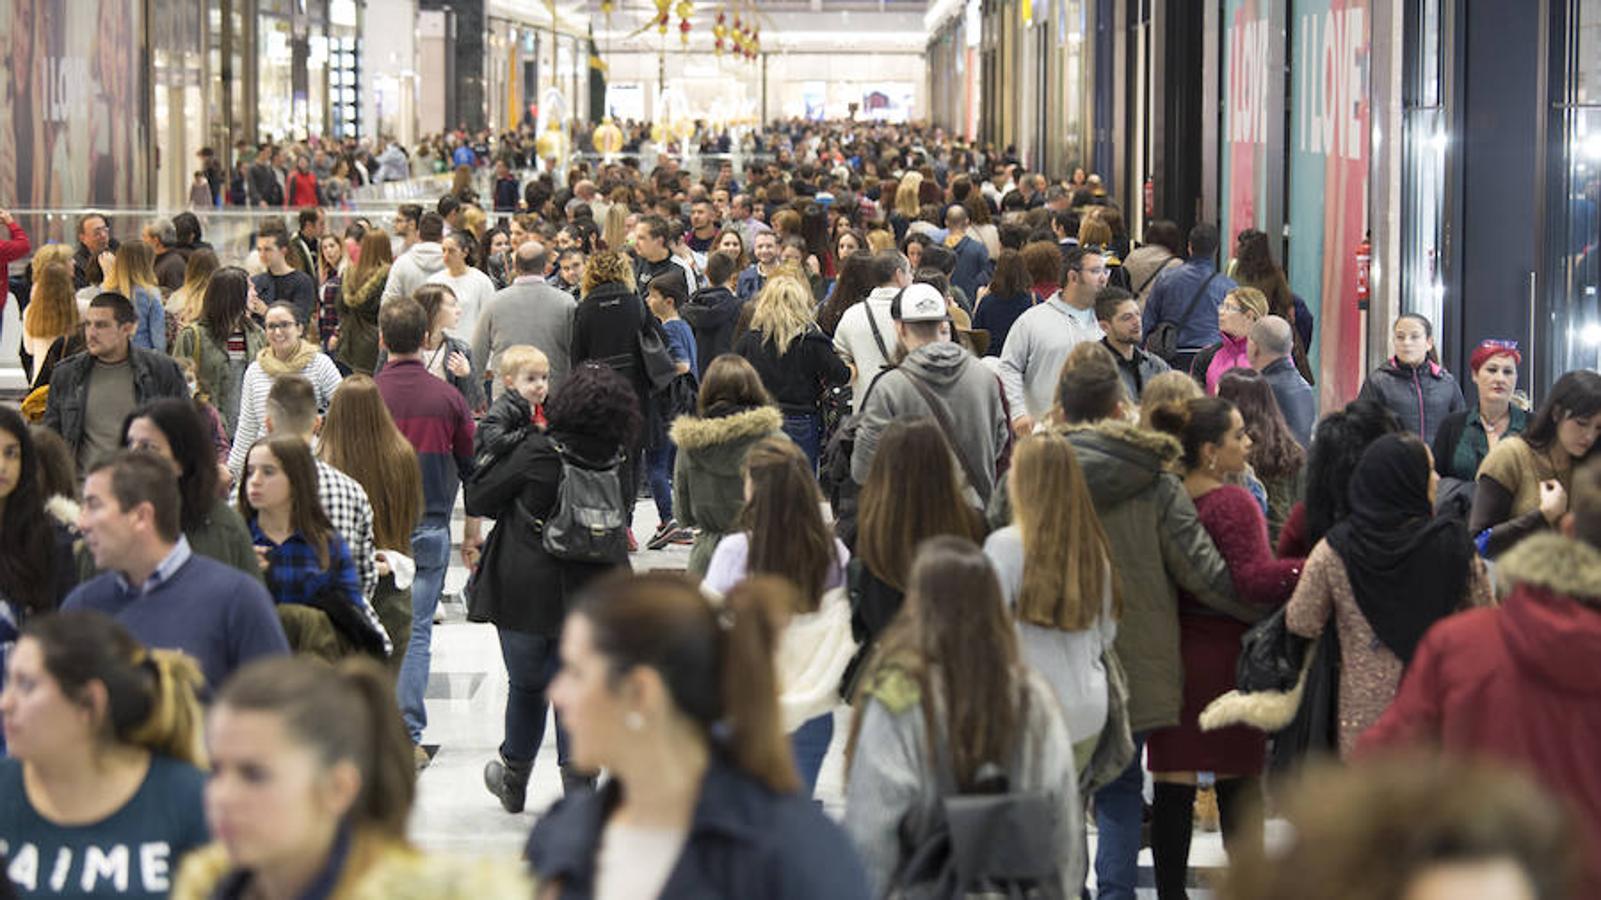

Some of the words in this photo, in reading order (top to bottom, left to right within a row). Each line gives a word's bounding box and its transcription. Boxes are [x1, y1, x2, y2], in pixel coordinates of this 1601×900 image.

[1227, 28, 1232, 142] I
[1301, 15, 1308, 151] I
[1311, 7, 1363, 160] LOVE
